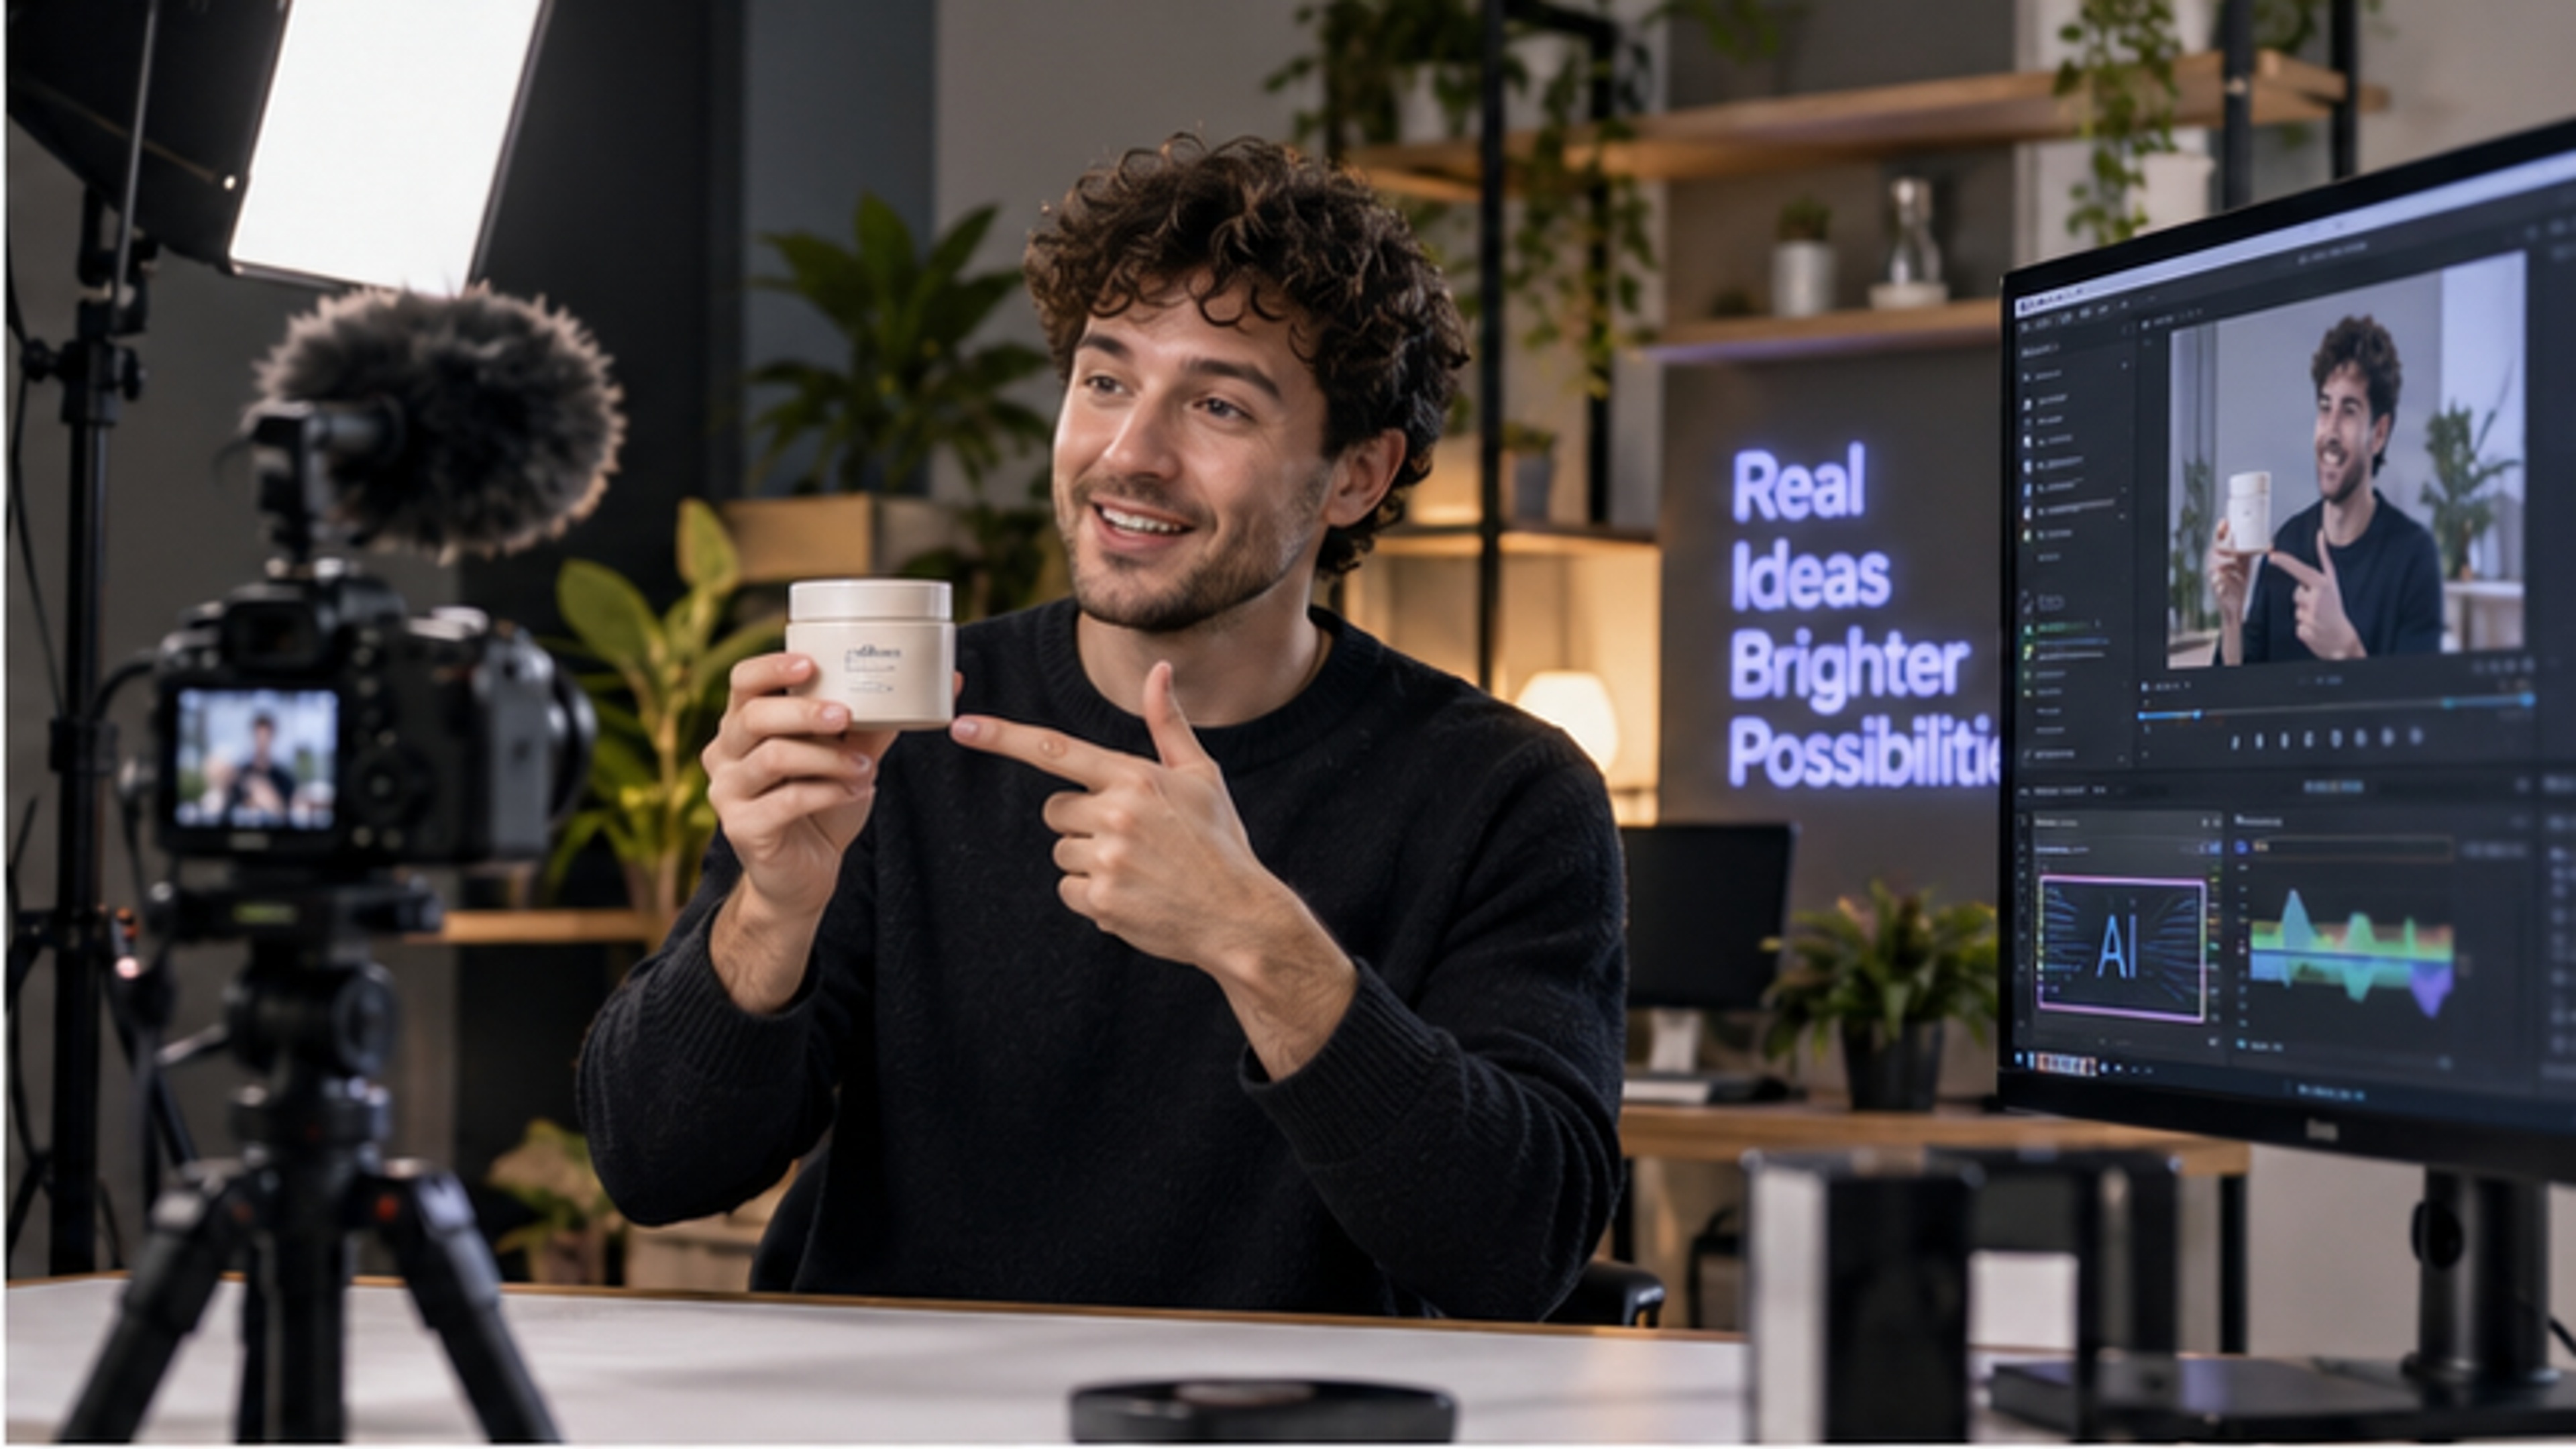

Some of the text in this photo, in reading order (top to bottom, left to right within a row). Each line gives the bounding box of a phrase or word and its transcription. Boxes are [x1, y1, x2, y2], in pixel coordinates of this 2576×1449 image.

[1733, 441, 1865, 523] Real
[1732, 537, 1892, 612] Ideas
[1731, 625, 1971, 715] Brighter
